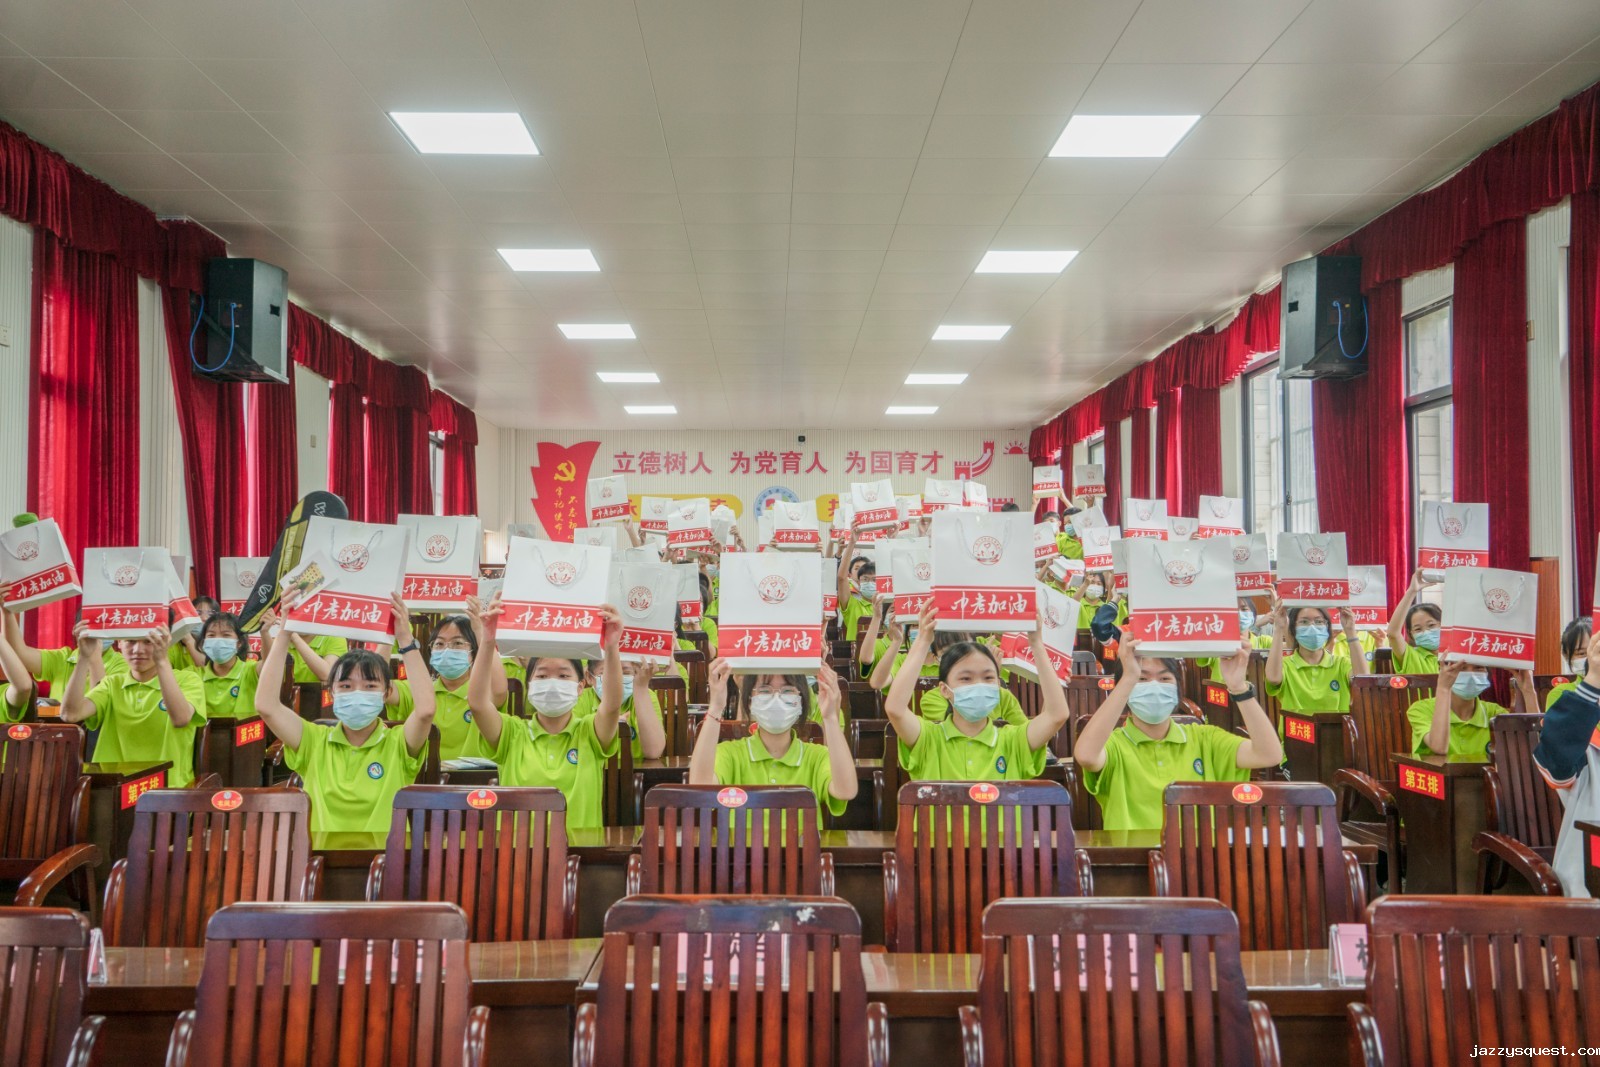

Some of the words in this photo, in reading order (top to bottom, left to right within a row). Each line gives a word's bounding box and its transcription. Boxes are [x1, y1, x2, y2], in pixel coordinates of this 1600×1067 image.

[612, 451, 712, 474] 立德树人
[730, 451, 828, 474] 为党育人
[845, 450, 944, 474] 为国育才
[860, 511, 892, 525] 中考加油
[780, 531, 812, 543] 中考加油
[1428, 553, 1479, 568] 中考加油
[16, 570, 65, 599] 中考加油
[403, 579, 463, 600] 中考加油
[1293, 580, 1344, 600] 中考加油
[304, 595, 383, 625] 中考加油
[950, 590, 1028, 620] 中考加油
[95, 608, 157, 630] 中考加油
[515, 605, 594, 631] 中考加油
[1144, 612, 1225, 642] 中考加油
[734, 630, 813, 657] 中考加油
[1460, 629, 1525, 655] 中考加油
[1209, 689, 1226, 704] 第七排
[240, 723, 262, 743] 第六排
[1288, 720, 1311, 740] 第六排
[1405, 767, 1439, 795] 第五排
